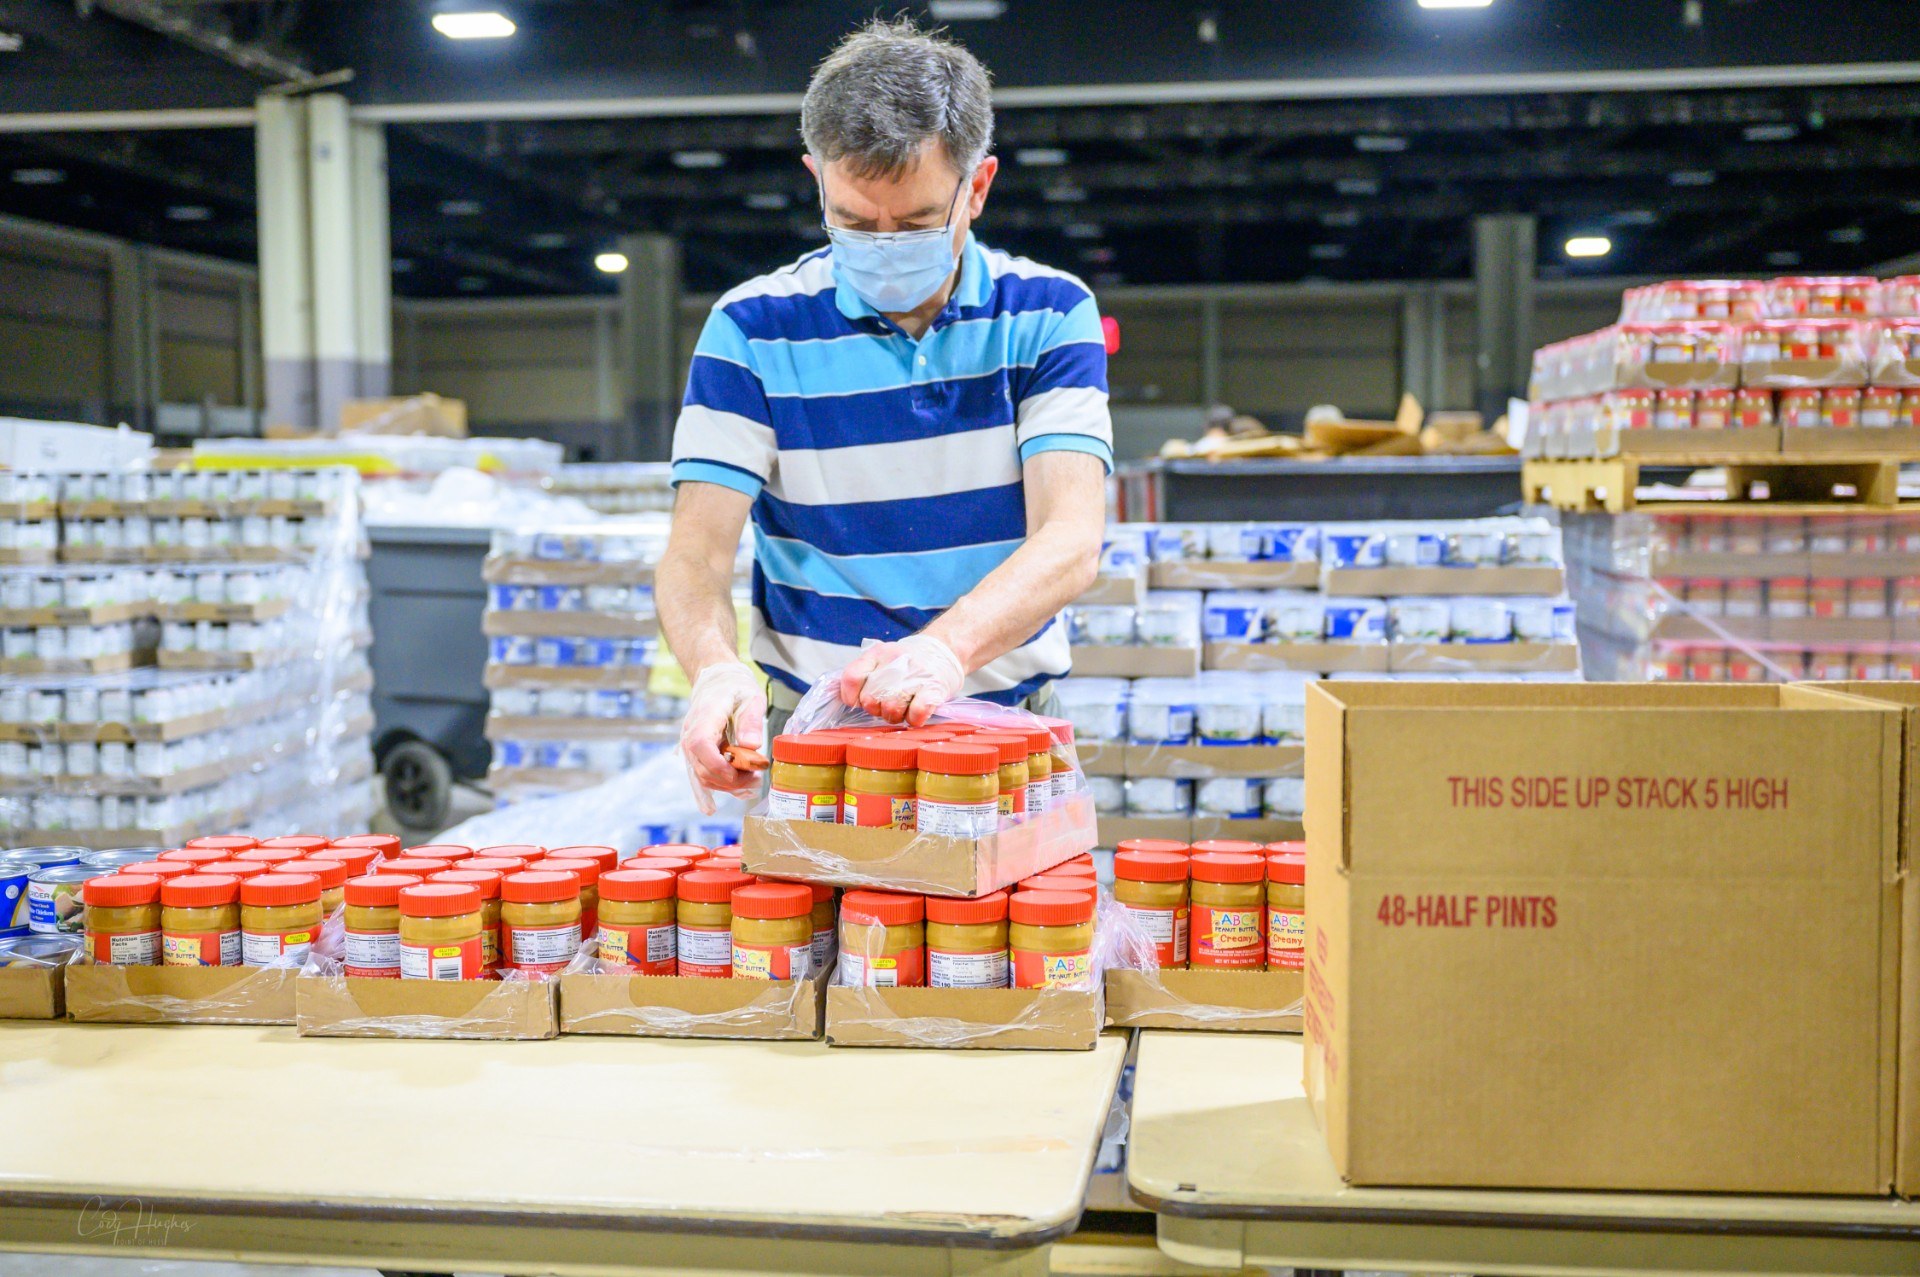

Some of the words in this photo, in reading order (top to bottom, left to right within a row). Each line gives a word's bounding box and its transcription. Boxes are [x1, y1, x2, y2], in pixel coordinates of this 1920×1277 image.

[1448, 776, 1503, 808] THIS
[1511, 776, 1567, 808] SIDE
[1576, 777, 1609, 808] UP
[1617, 777, 1696, 809] STACK
[1705, 778, 1718, 808] 5
[1726, 778, 1787, 809] HIGH
[1376, 894, 1478, 928] 48-HALF
[1485, 895, 1557, 928] PINTS
[1221, 913, 1251, 926] ABC
[1273, 914, 1298, 928] ABC
[164, 938, 186, 952] ABC
[1220, 934, 1253, 944] Creamy
[1273, 934, 1303, 946] Creamy
[734, 950, 757, 964] ABC
[1056, 958, 1084, 972] ABC
